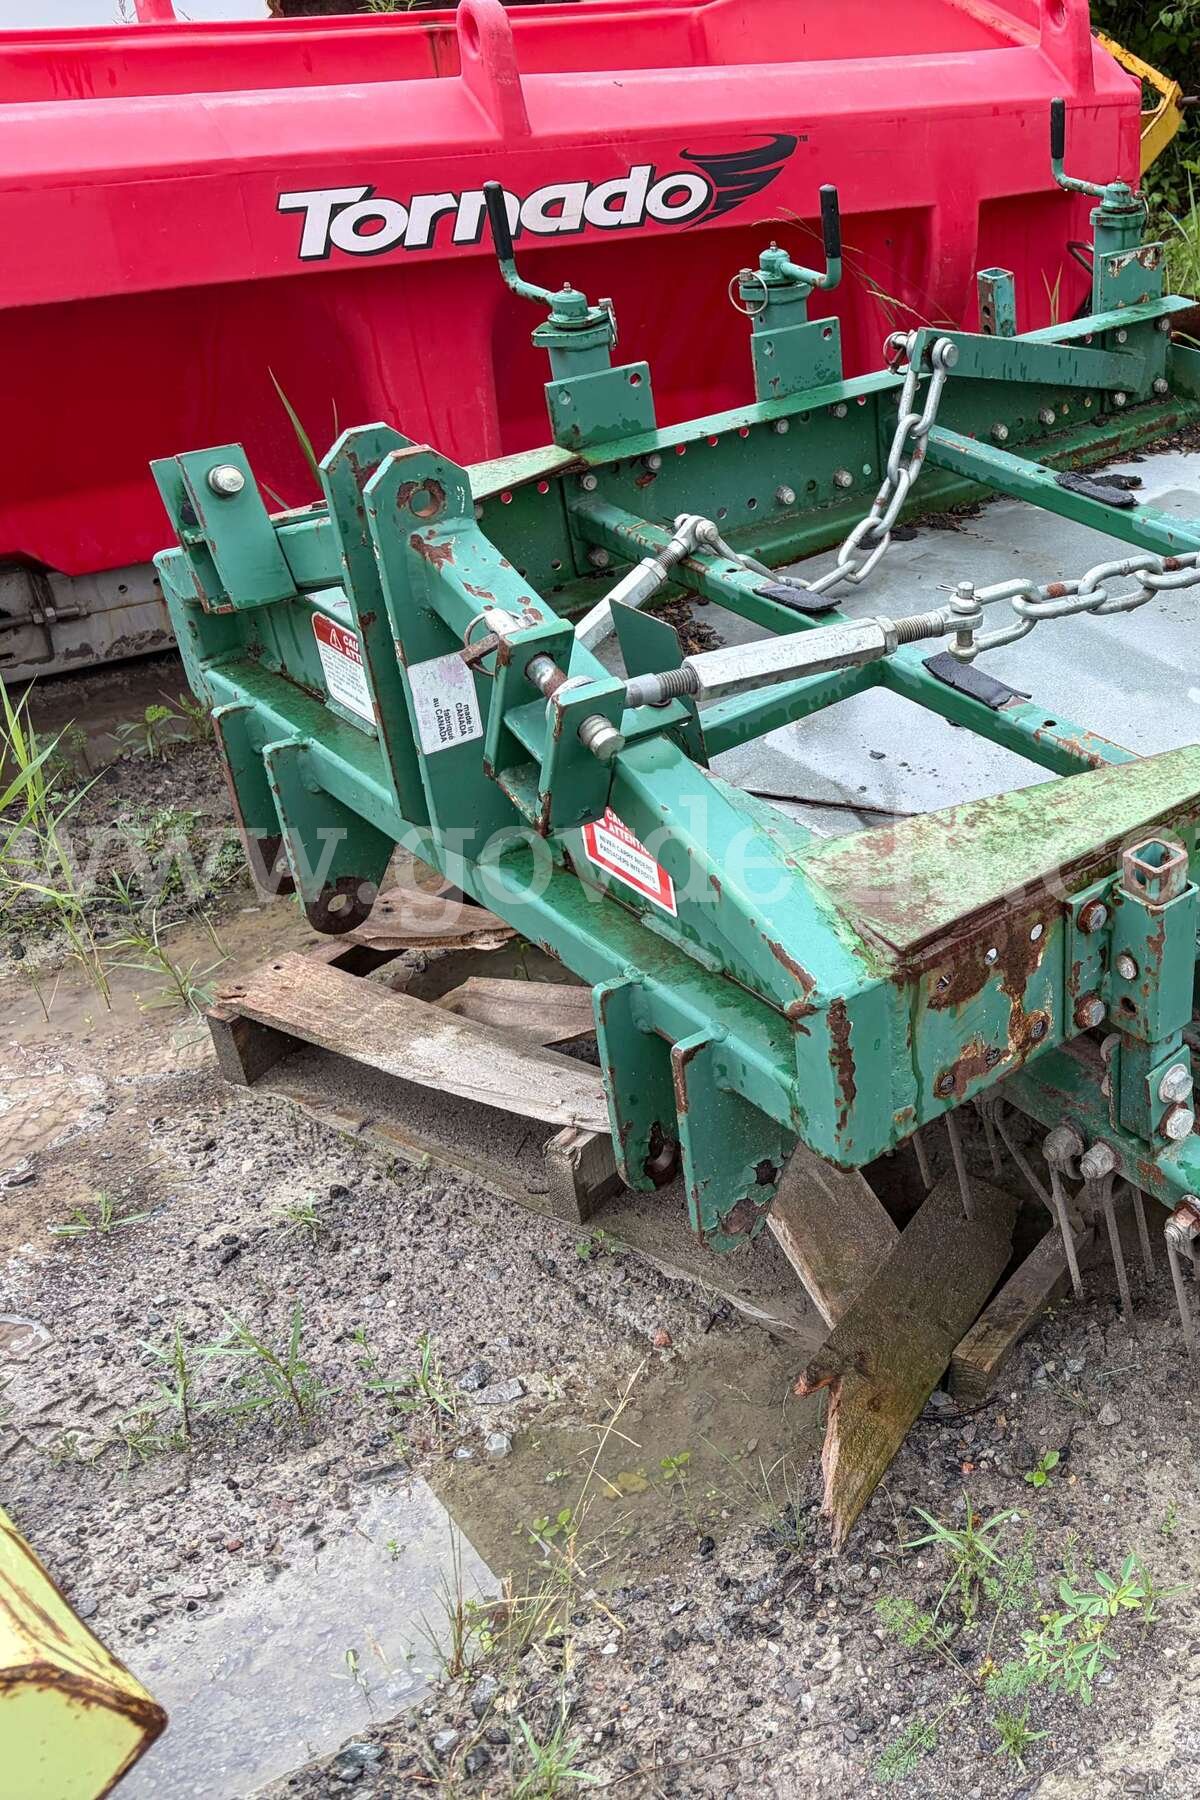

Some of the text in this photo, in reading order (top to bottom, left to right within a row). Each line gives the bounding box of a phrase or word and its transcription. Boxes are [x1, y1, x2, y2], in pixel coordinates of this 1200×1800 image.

[277, 164, 714, 262] Tornado
[343, 635, 359, 652] CAU
[433, 697, 448, 743] au CANADA
[455, 702, 468, 737] CANADA
[463, 703, 475, 735] made in
